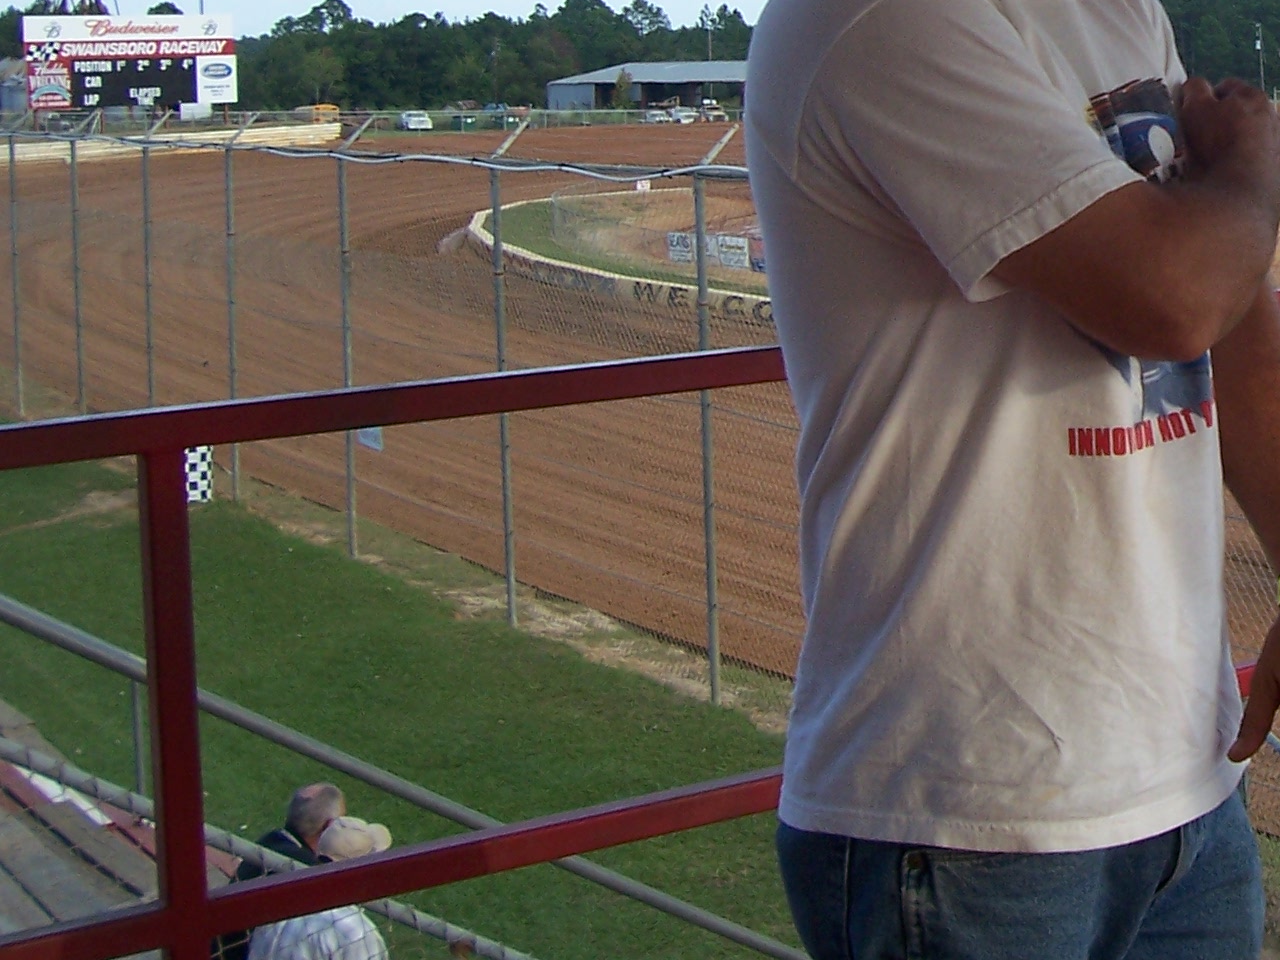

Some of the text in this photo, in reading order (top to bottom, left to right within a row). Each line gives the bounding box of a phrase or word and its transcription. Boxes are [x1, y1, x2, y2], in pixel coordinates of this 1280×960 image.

[85, 19, 179, 37] Budweiser
[61, 40, 227, 57] SWAINSBORO RACEWAY
[74, 60, 112, 72] POSITION
[84, 76, 102, 88] CAR
[84, 94, 100, 105] LAP
[1157, 407, 1197, 443] NOT
